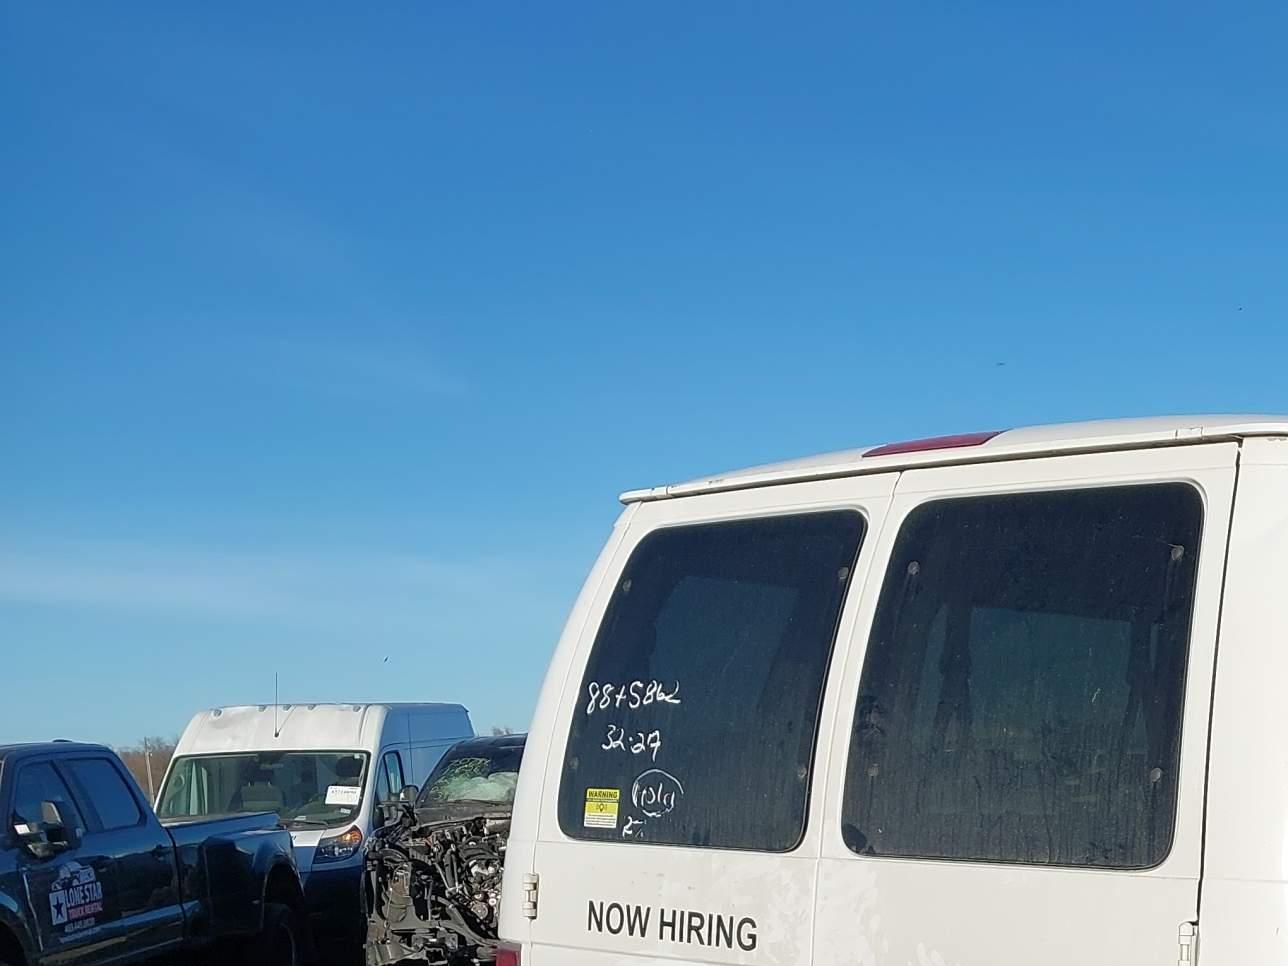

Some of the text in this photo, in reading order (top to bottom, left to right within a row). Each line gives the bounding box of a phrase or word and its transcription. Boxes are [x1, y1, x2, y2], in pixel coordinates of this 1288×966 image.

[588, 790, 618, 799] WARNING
[64, 881, 103, 908] LONE STAR
[587, 900, 758, 951] NOW HIRING
